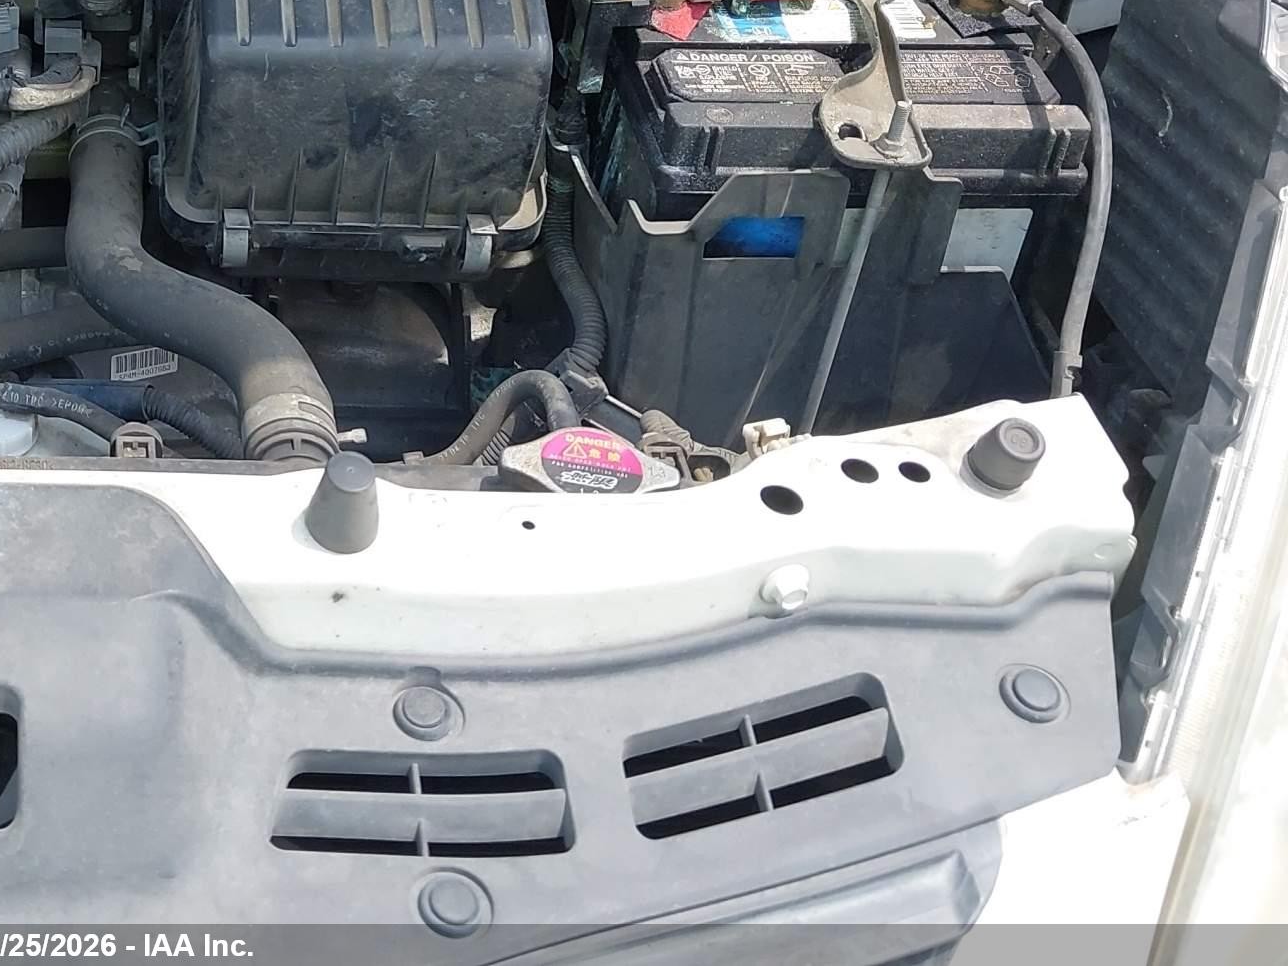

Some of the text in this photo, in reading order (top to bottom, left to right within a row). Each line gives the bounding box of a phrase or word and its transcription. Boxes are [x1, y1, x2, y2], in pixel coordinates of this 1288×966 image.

[689, 53, 748, 62] DANGER
[761, 54, 815, 63] POISON
[565, 434, 622, 450] DANGER
